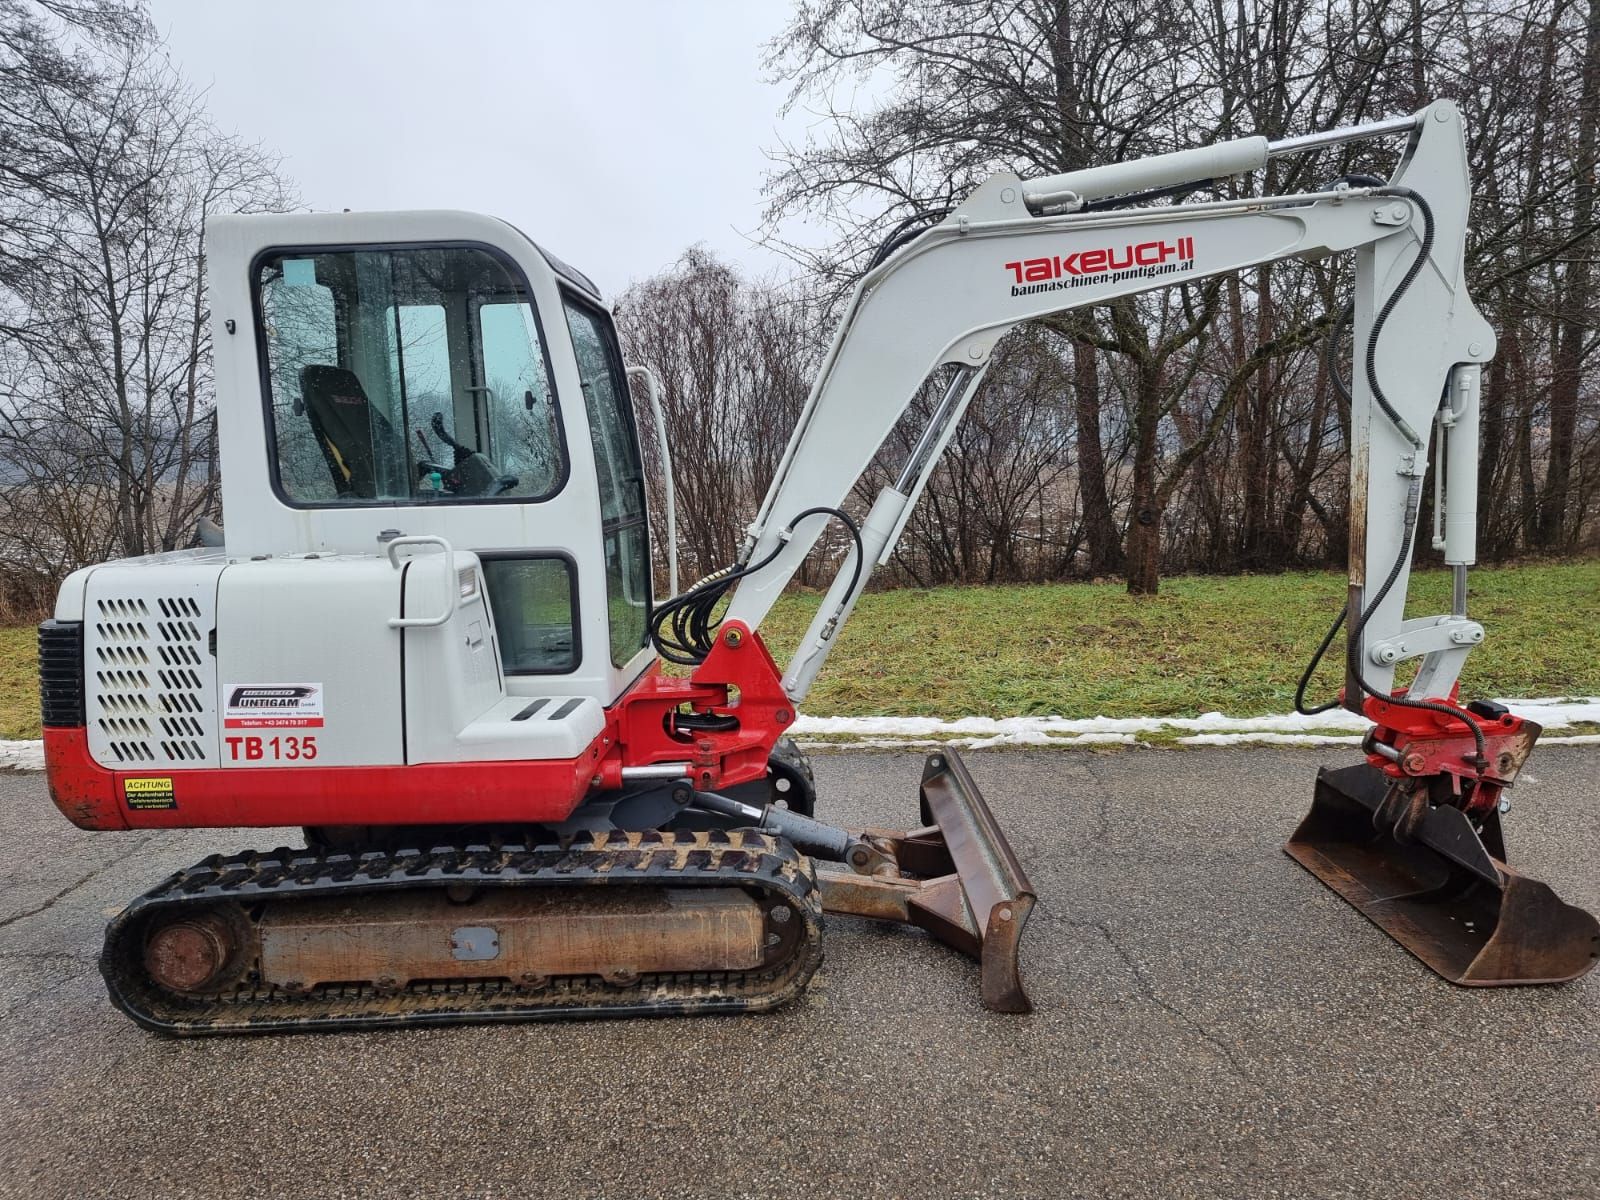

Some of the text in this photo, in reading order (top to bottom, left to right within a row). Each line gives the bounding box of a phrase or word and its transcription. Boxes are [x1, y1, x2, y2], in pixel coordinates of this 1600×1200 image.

[1005, 237, 1194, 284] TAKEUCHI
[1010, 259, 1195, 297] baumaschinen-puntigam.at
[127, 781, 170, 789] ACHTUNG
